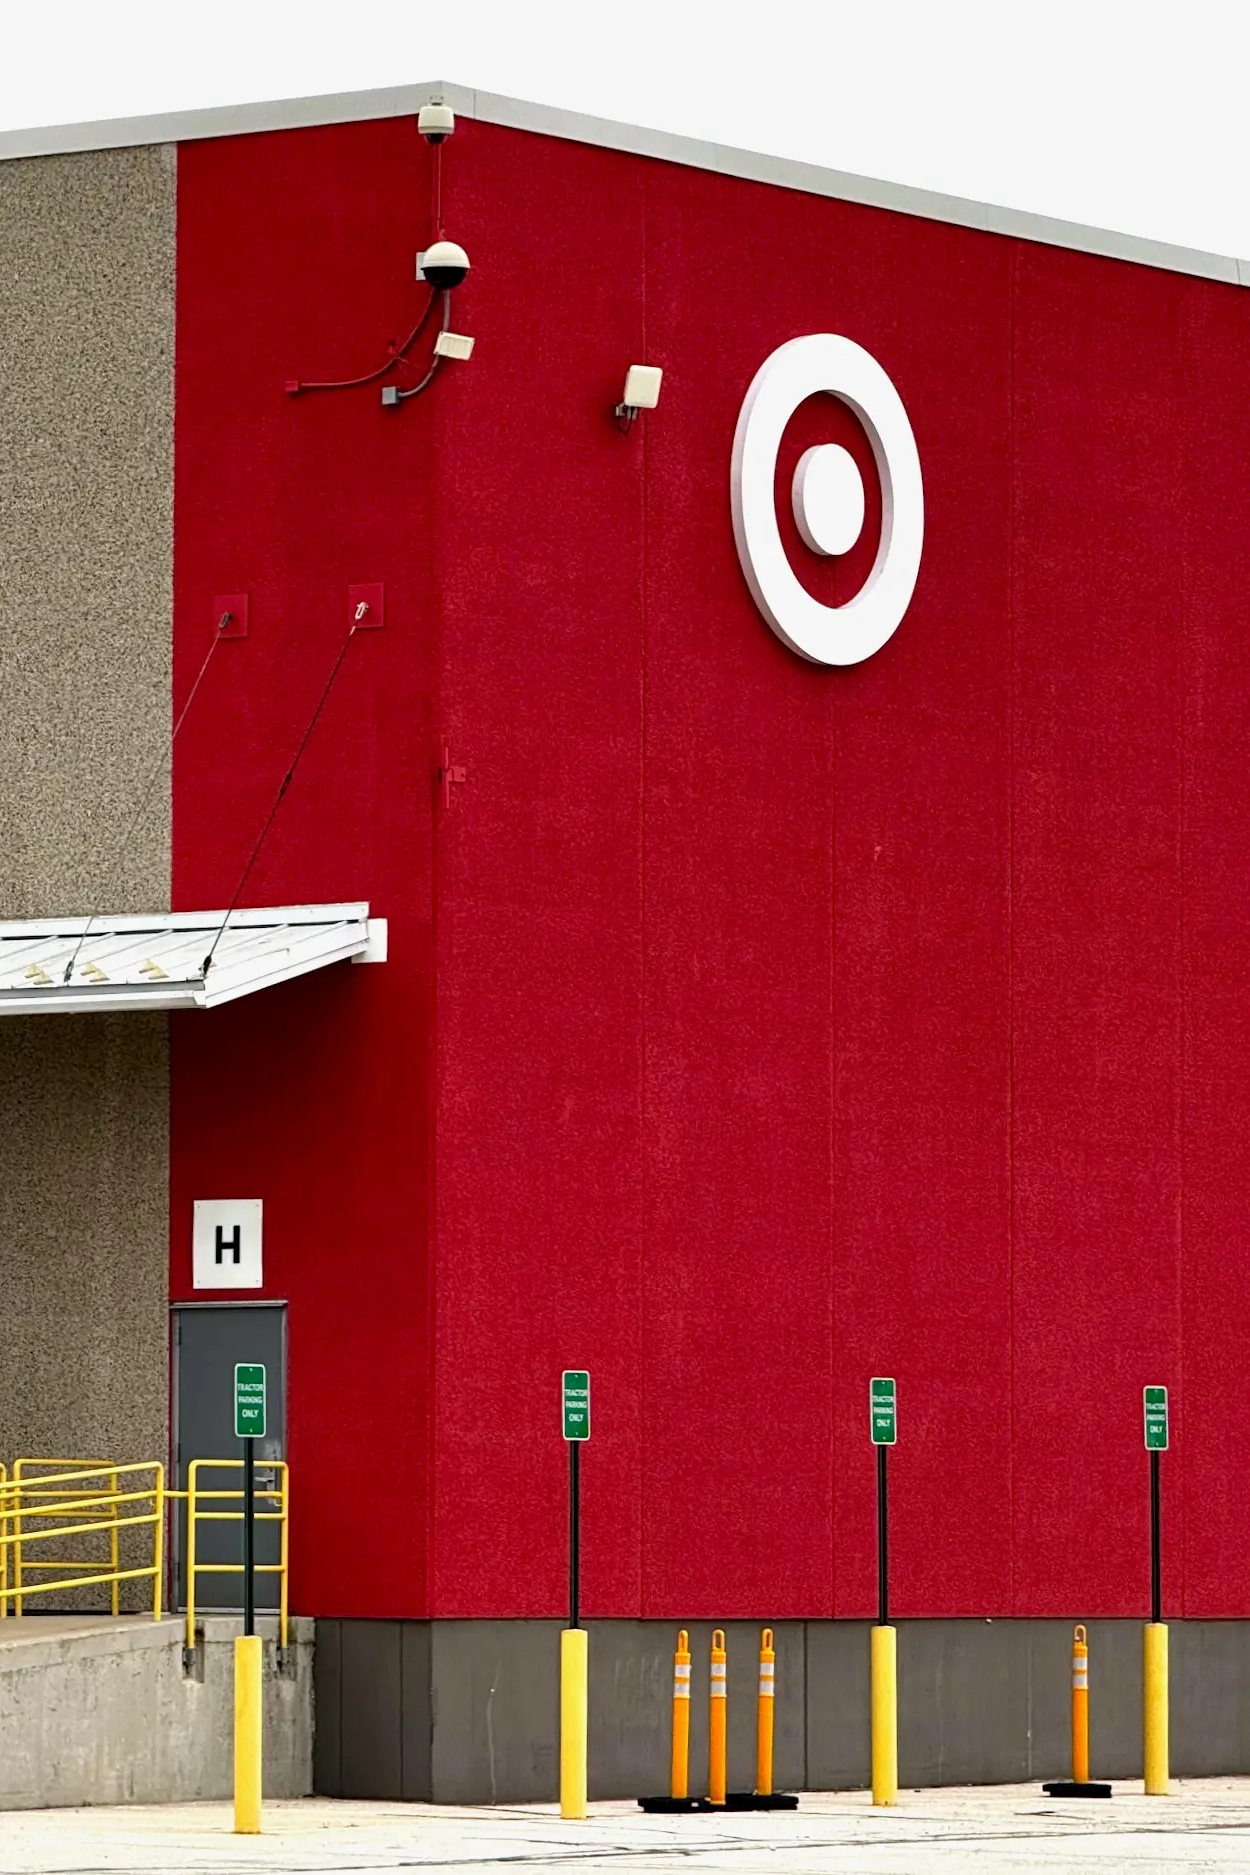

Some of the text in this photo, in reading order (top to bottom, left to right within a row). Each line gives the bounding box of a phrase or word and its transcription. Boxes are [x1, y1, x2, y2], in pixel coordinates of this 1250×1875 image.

[215, 1225, 241, 1264] H
[238, 1383, 264, 1391] TRACTOR
[242, 1409, 258, 1418] ONLY
